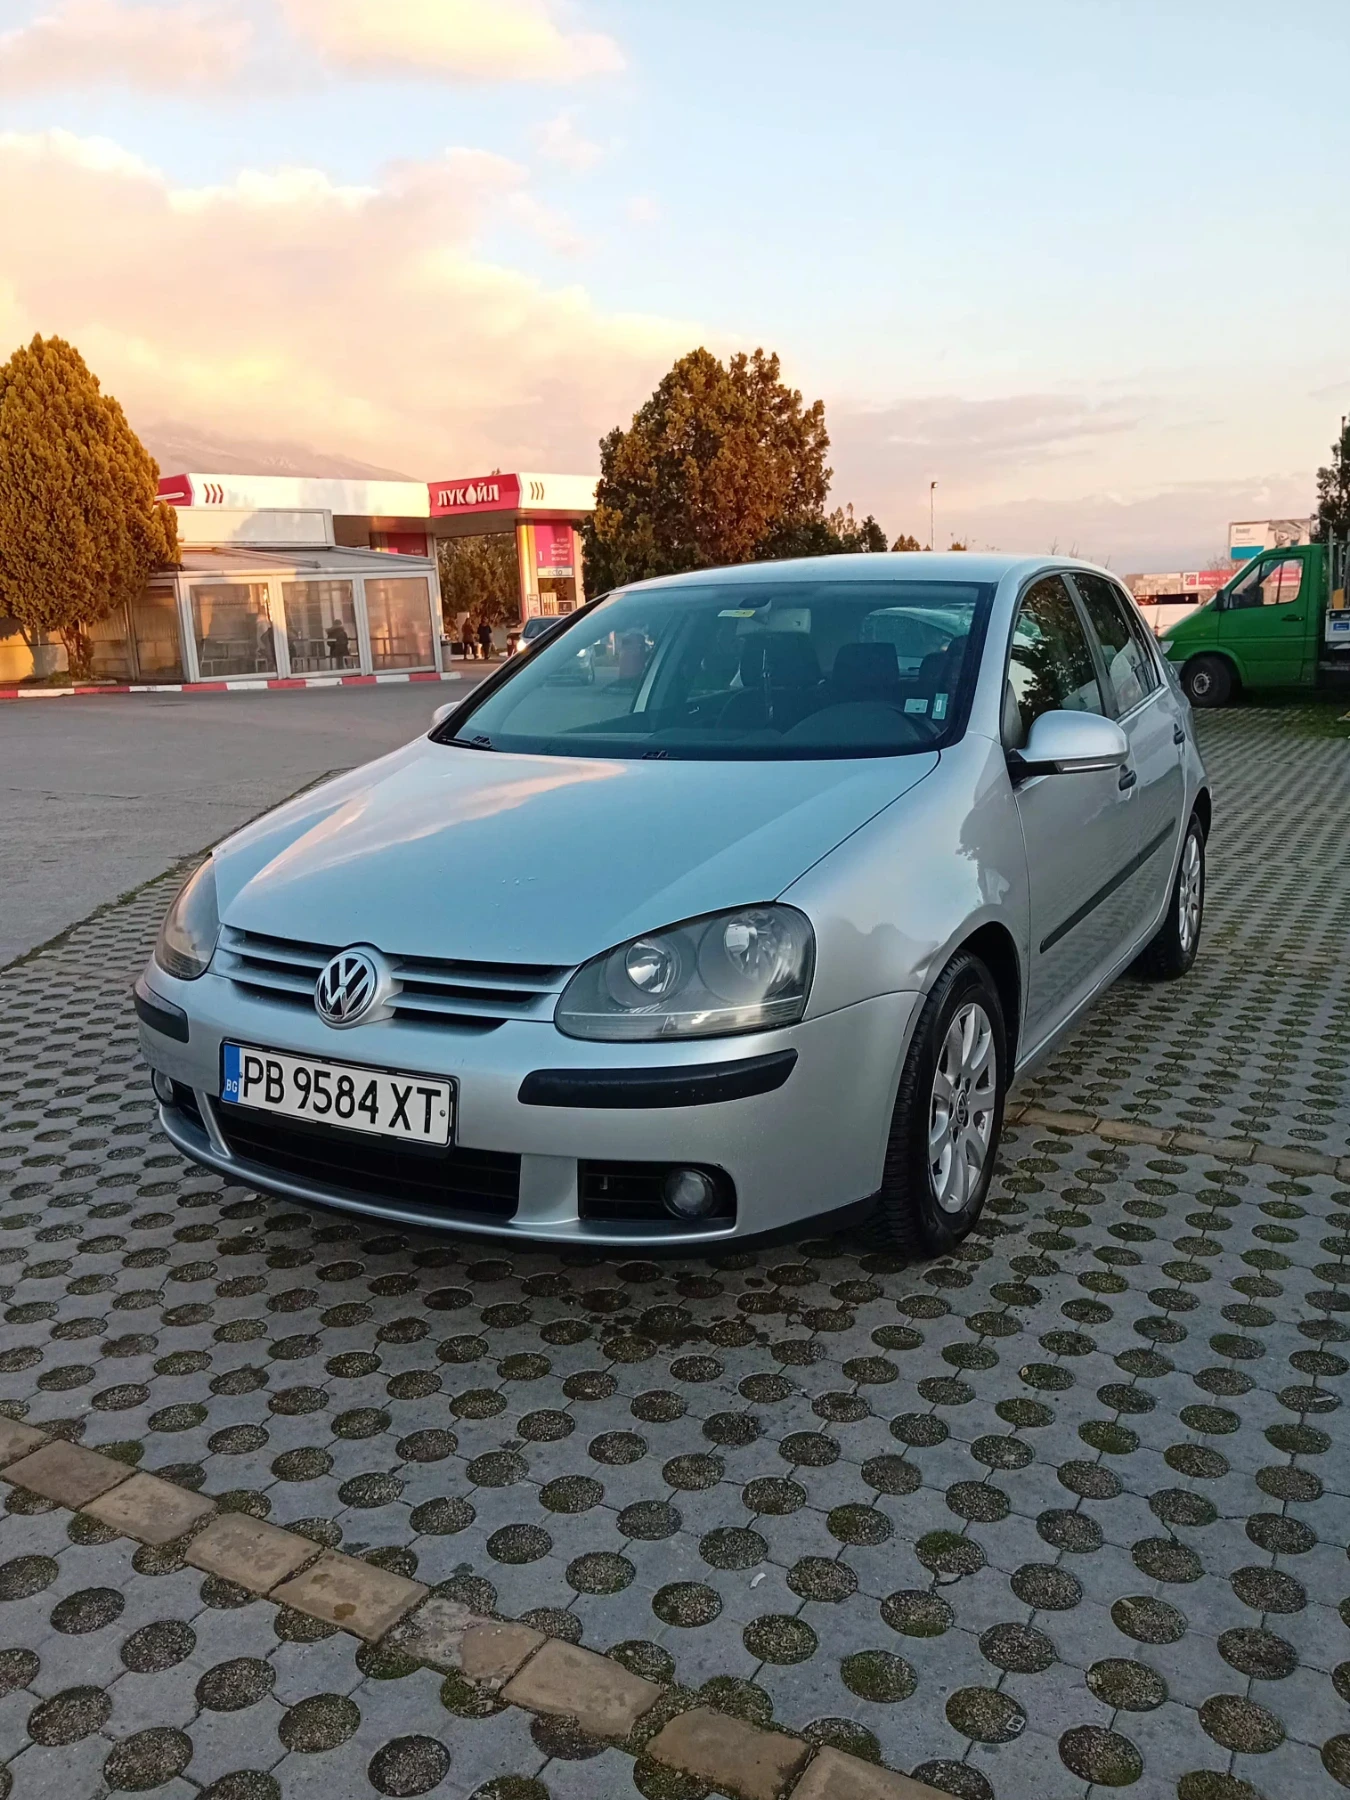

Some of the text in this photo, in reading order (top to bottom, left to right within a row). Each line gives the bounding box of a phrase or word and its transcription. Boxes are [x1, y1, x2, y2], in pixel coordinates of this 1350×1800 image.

[319, 953, 375, 1022] VW
[226, 1078, 238, 1093] BG
[243, 1055, 441, 1134] PB 9584 XT
